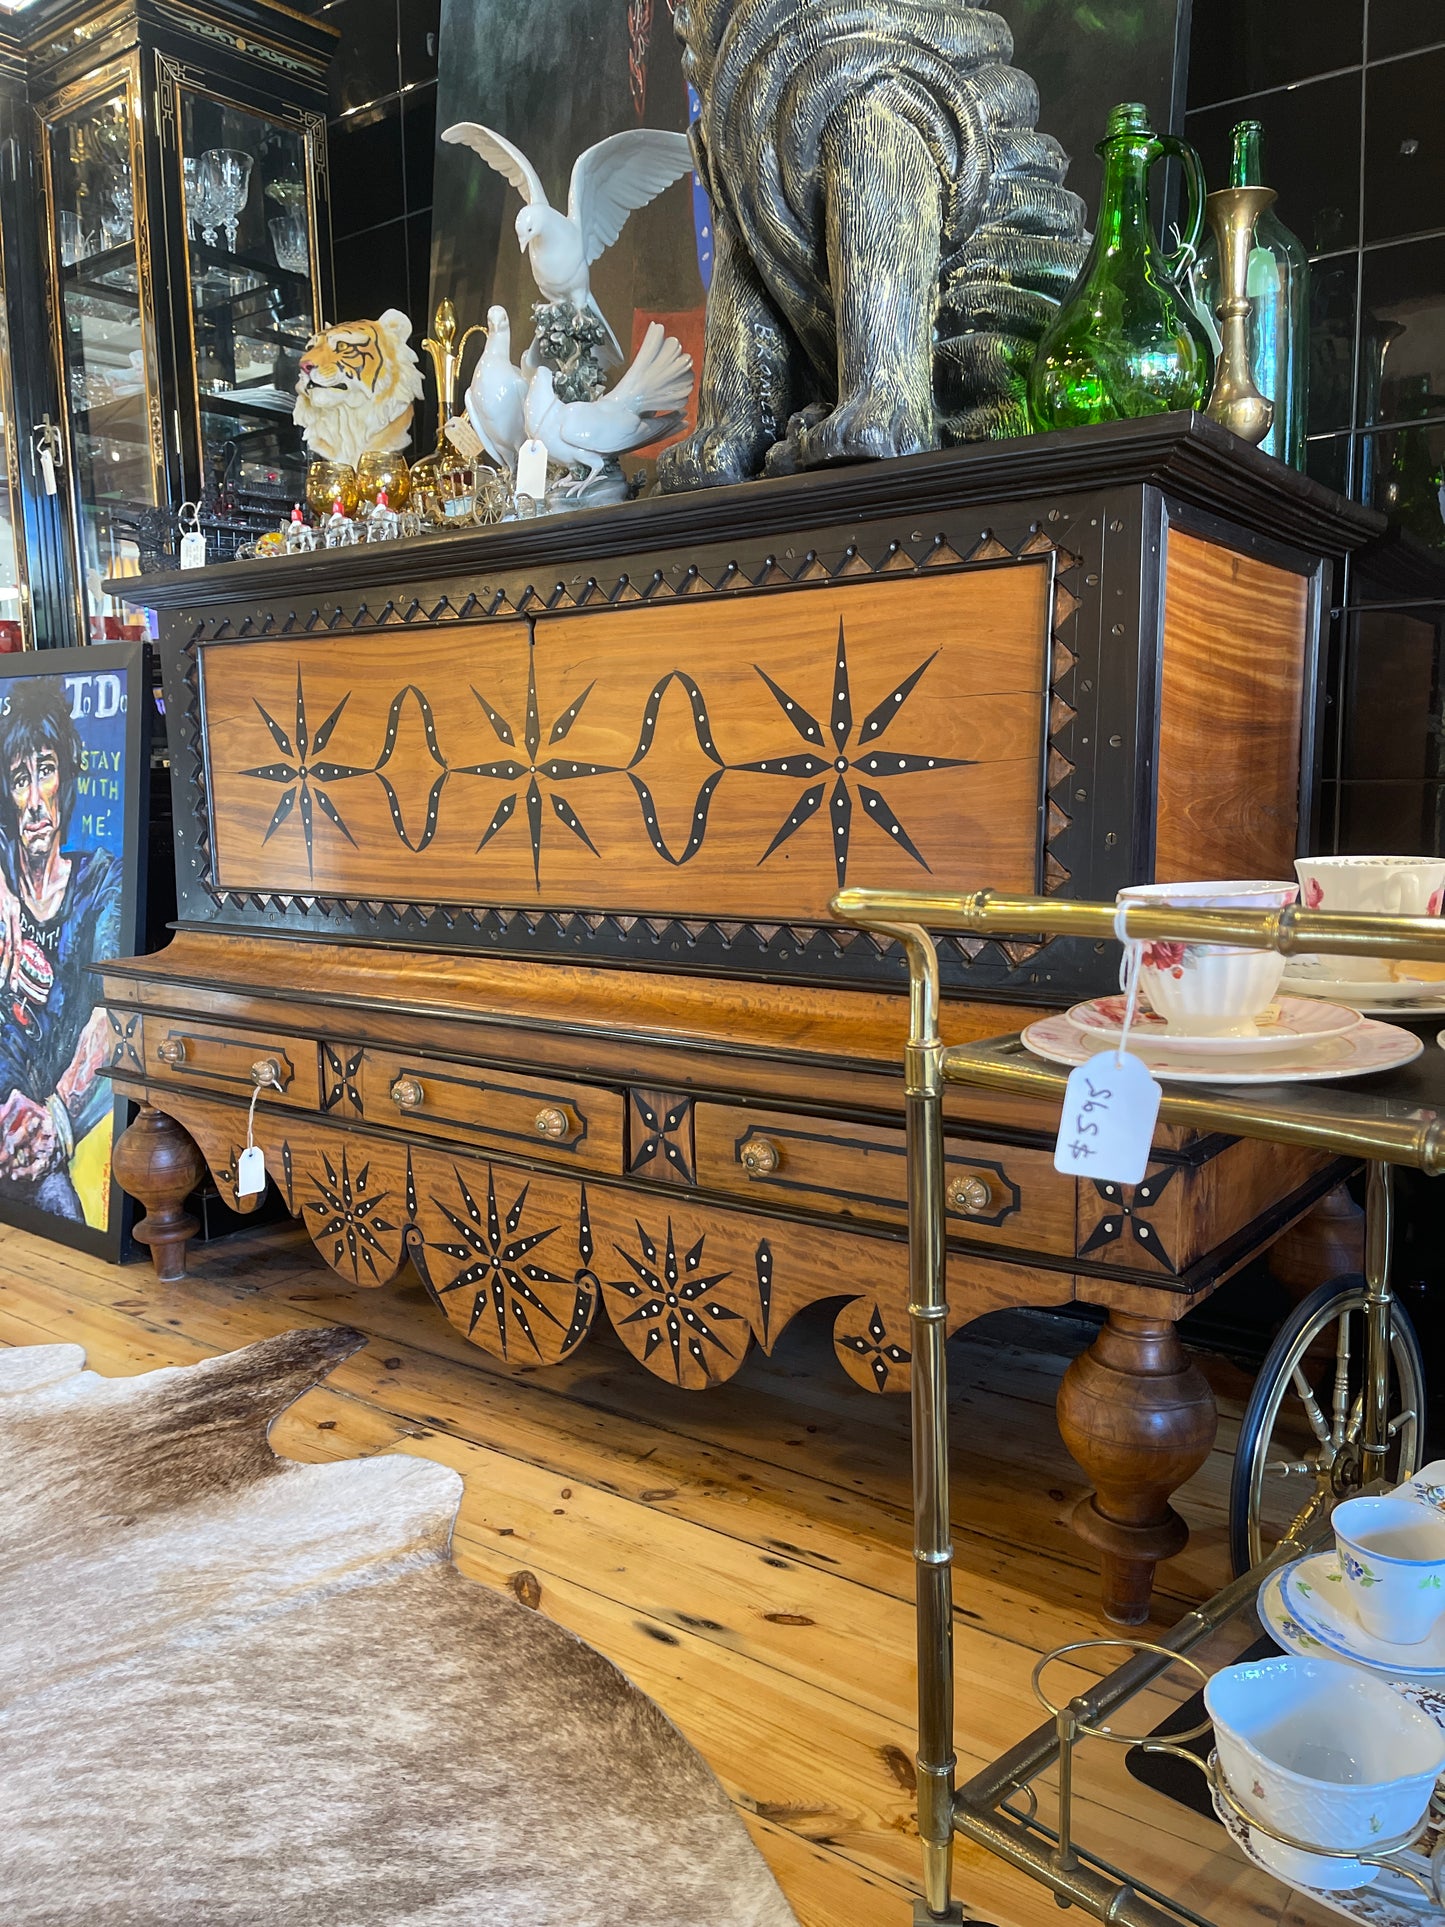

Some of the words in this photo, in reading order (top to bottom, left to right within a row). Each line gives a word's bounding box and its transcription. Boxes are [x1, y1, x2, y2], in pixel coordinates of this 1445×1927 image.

[754, 322, 778, 441] BROMLEY
[77, 776, 119, 801] WITH
[20, 912, 60, 950] DONT!
[1067, 1077, 1112, 1160] $595
